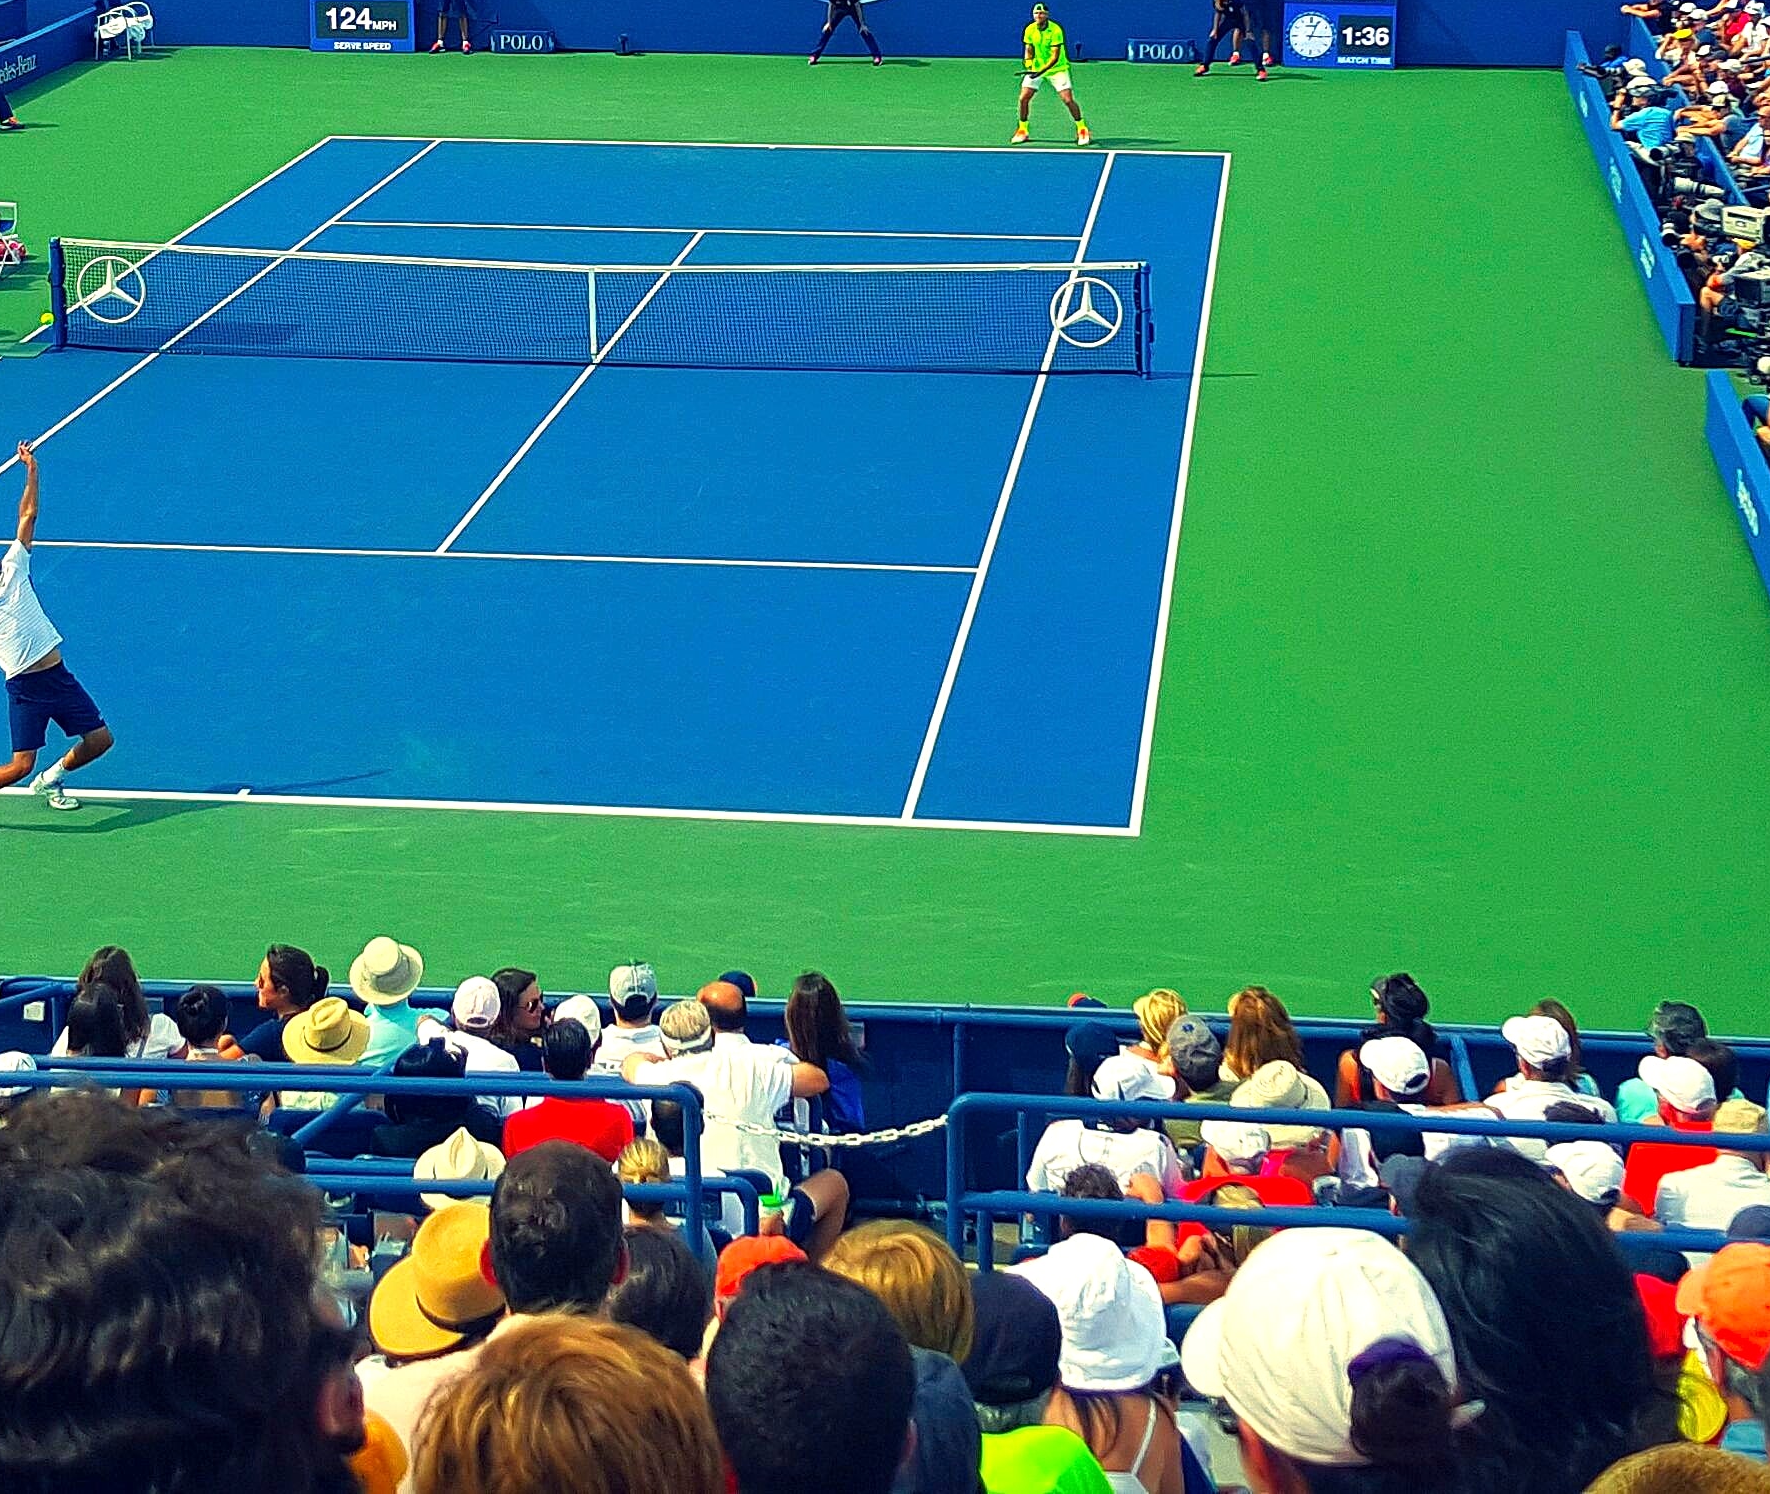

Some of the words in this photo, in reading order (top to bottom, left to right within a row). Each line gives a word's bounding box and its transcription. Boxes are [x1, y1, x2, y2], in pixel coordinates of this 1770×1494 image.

[326, 7, 372, 30] 124
[372, 21, 397, 31] MPH
[499, 35, 543, 51] POLO
[1342, 26, 1389, 46] 1:36
[334, 42, 361, 50] SERVE
[363, 42, 391, 50] SPEED
[1139, 44, 1184, 60] POLO
